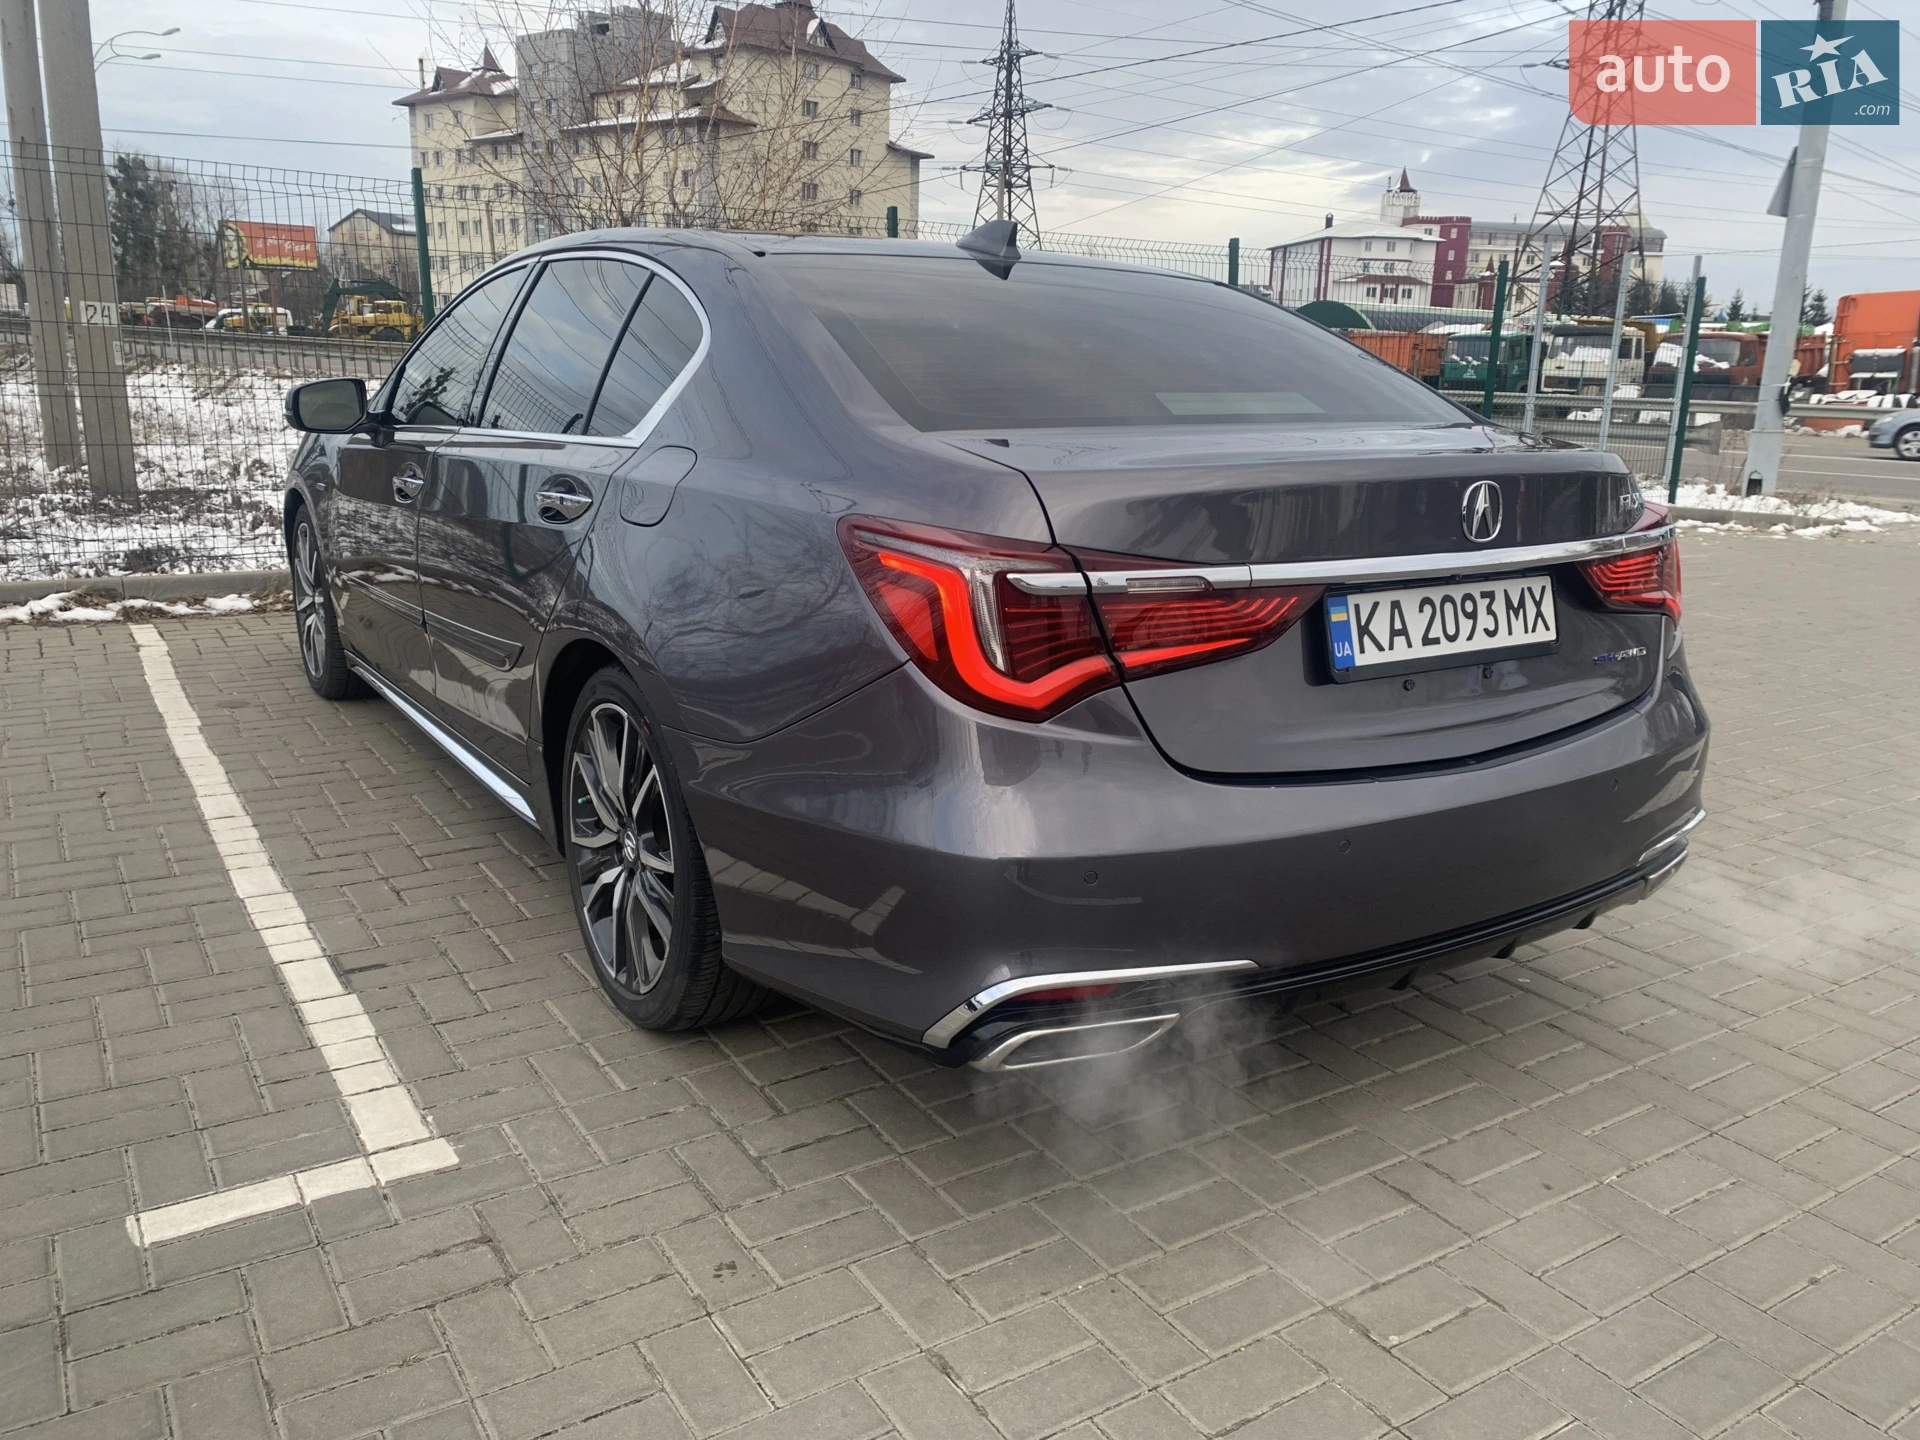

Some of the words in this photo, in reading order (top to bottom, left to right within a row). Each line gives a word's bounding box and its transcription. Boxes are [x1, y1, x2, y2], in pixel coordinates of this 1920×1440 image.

[86, 304, 111, 325] 24
[1353, 599, 1413, 654] KA
[1418, 589, 1499, 646] 2093
[1503, 585, 1551, 636] MX
[1334, 641, 1352, 657] UA
